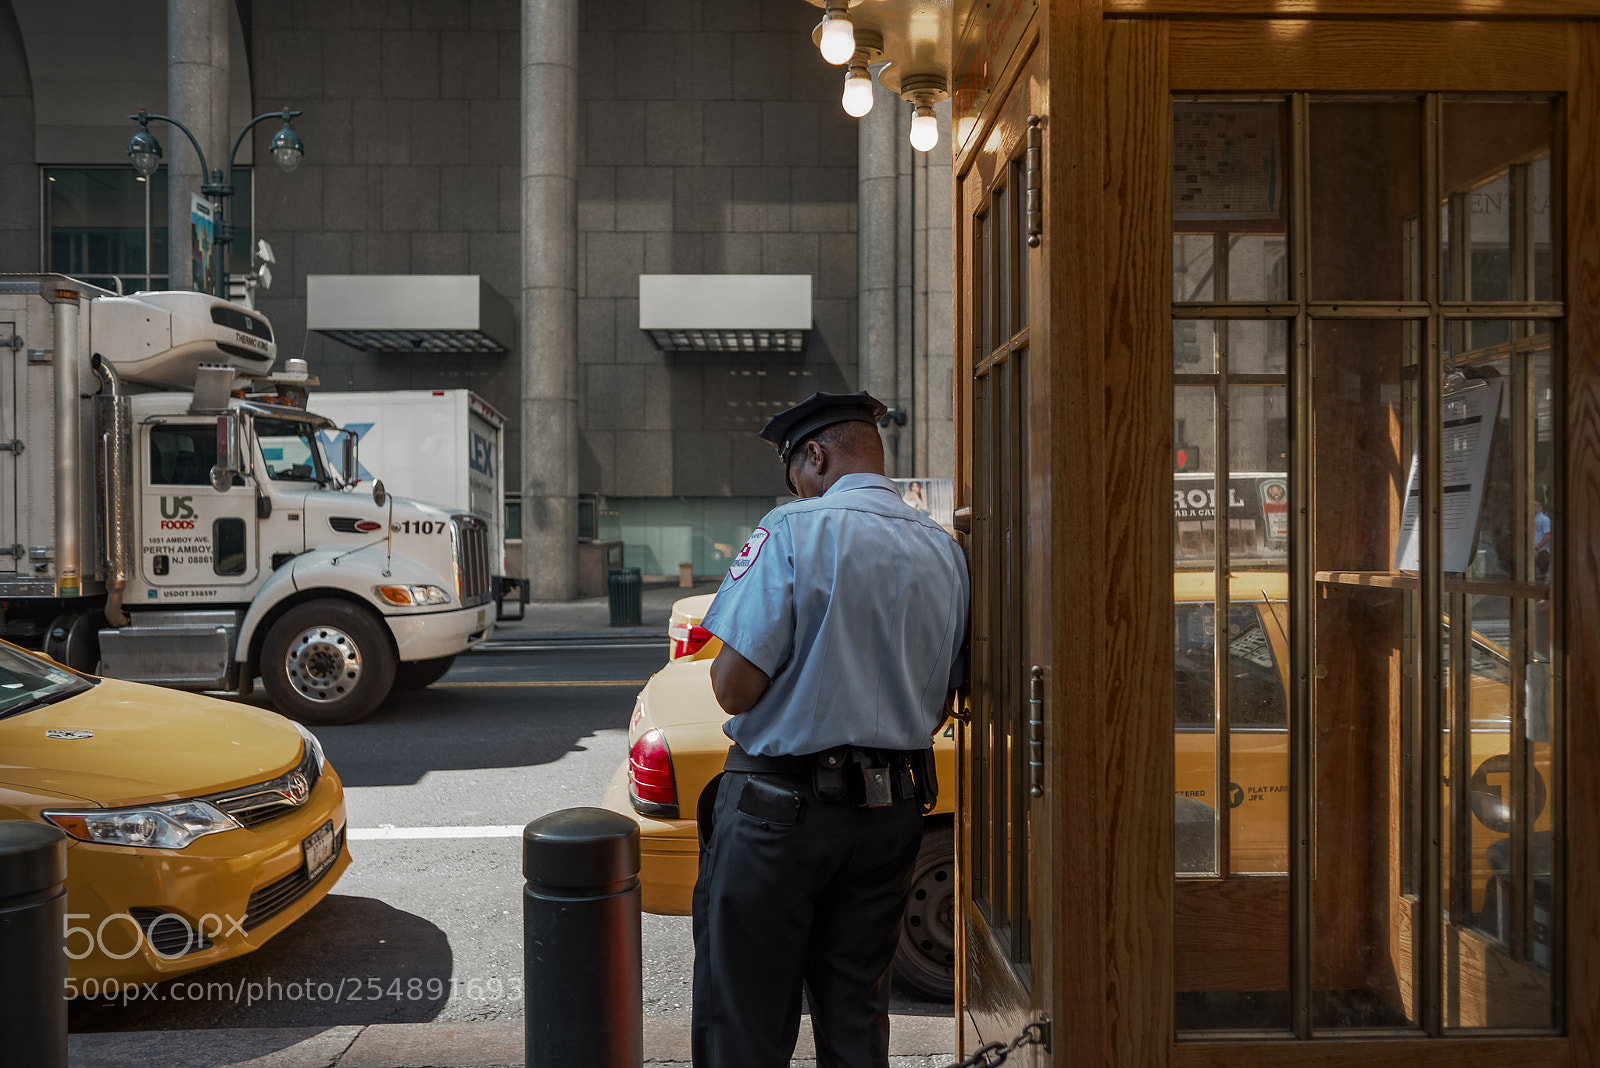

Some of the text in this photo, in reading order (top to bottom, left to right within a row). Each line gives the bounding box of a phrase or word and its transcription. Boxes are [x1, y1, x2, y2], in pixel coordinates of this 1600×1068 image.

[160, 520, 195, 530] FOODS
[401, 520, 446, 535] 1107
[143, 546, 175, 555] PERTH
[172, 556, 184, 564] NJ
